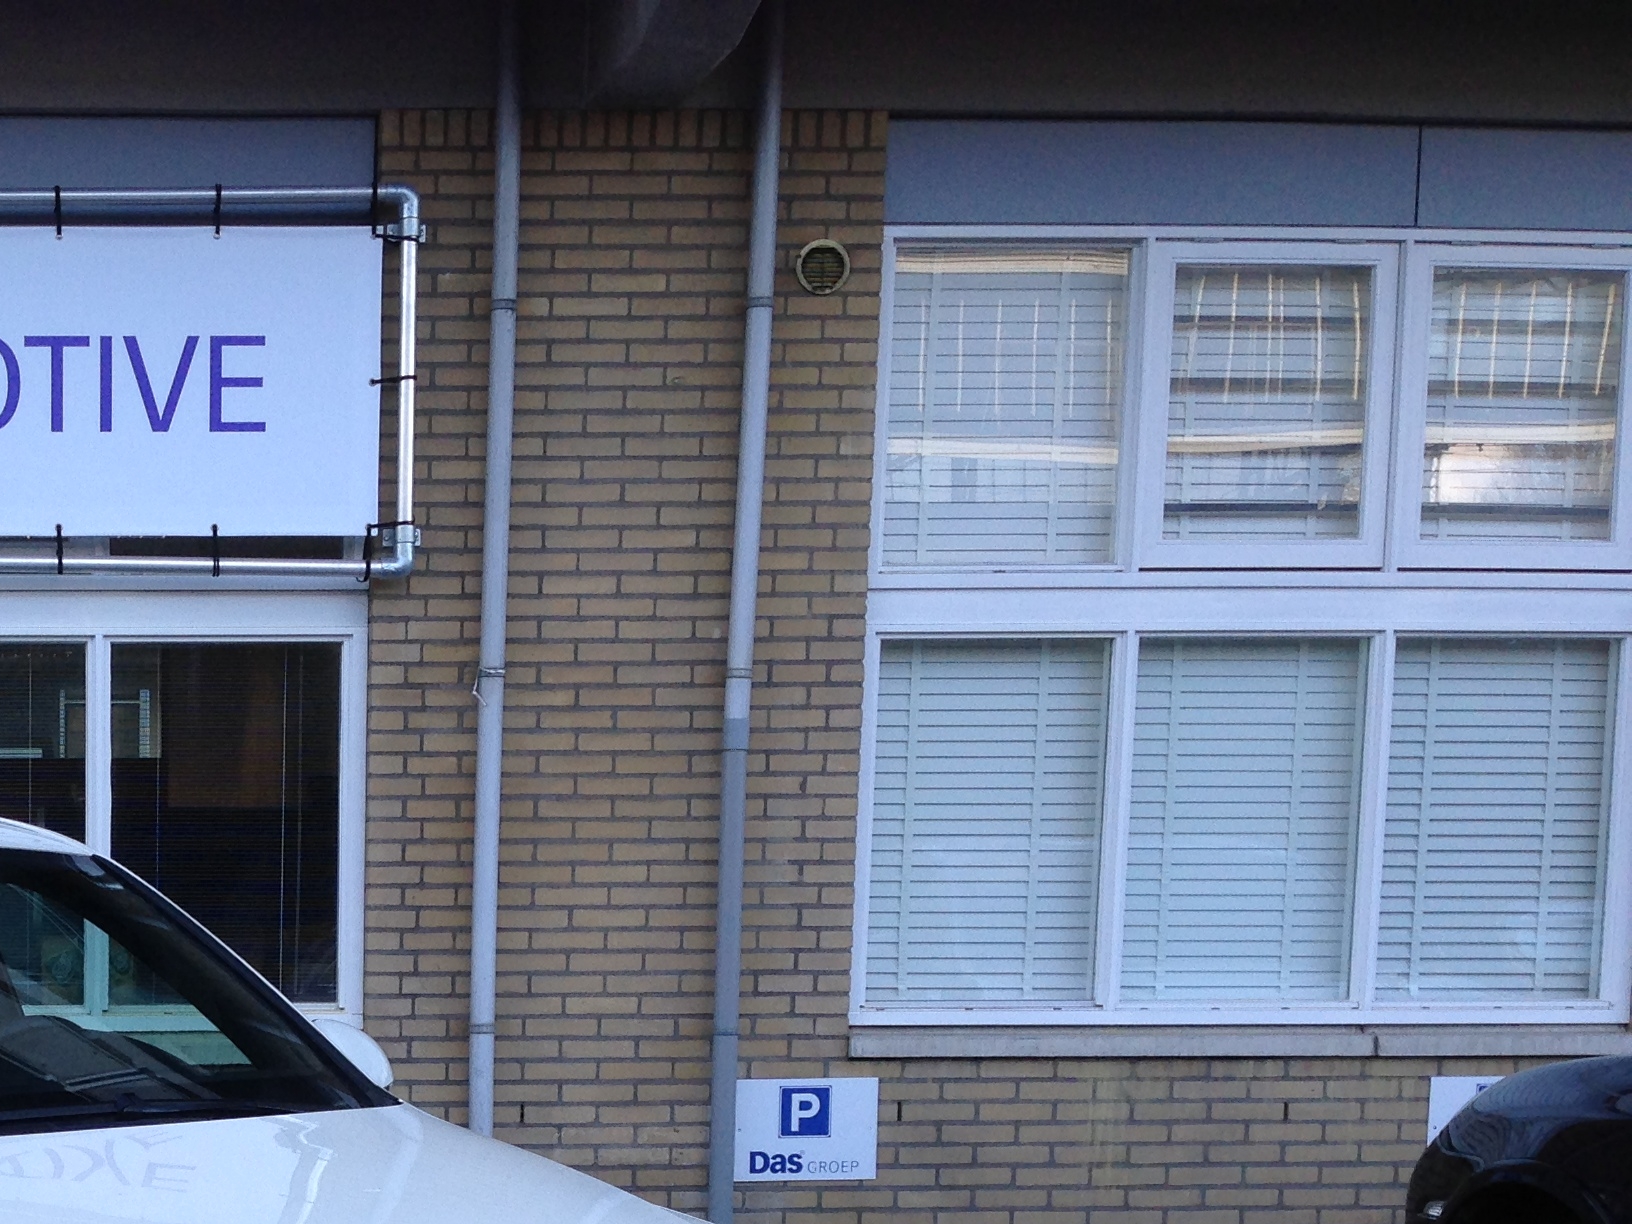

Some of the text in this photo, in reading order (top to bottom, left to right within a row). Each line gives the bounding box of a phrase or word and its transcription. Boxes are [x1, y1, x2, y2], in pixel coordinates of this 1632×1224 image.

[790, 1093, 821, 1132] P
[749, 1151, 859, 1174] Das GROEP
